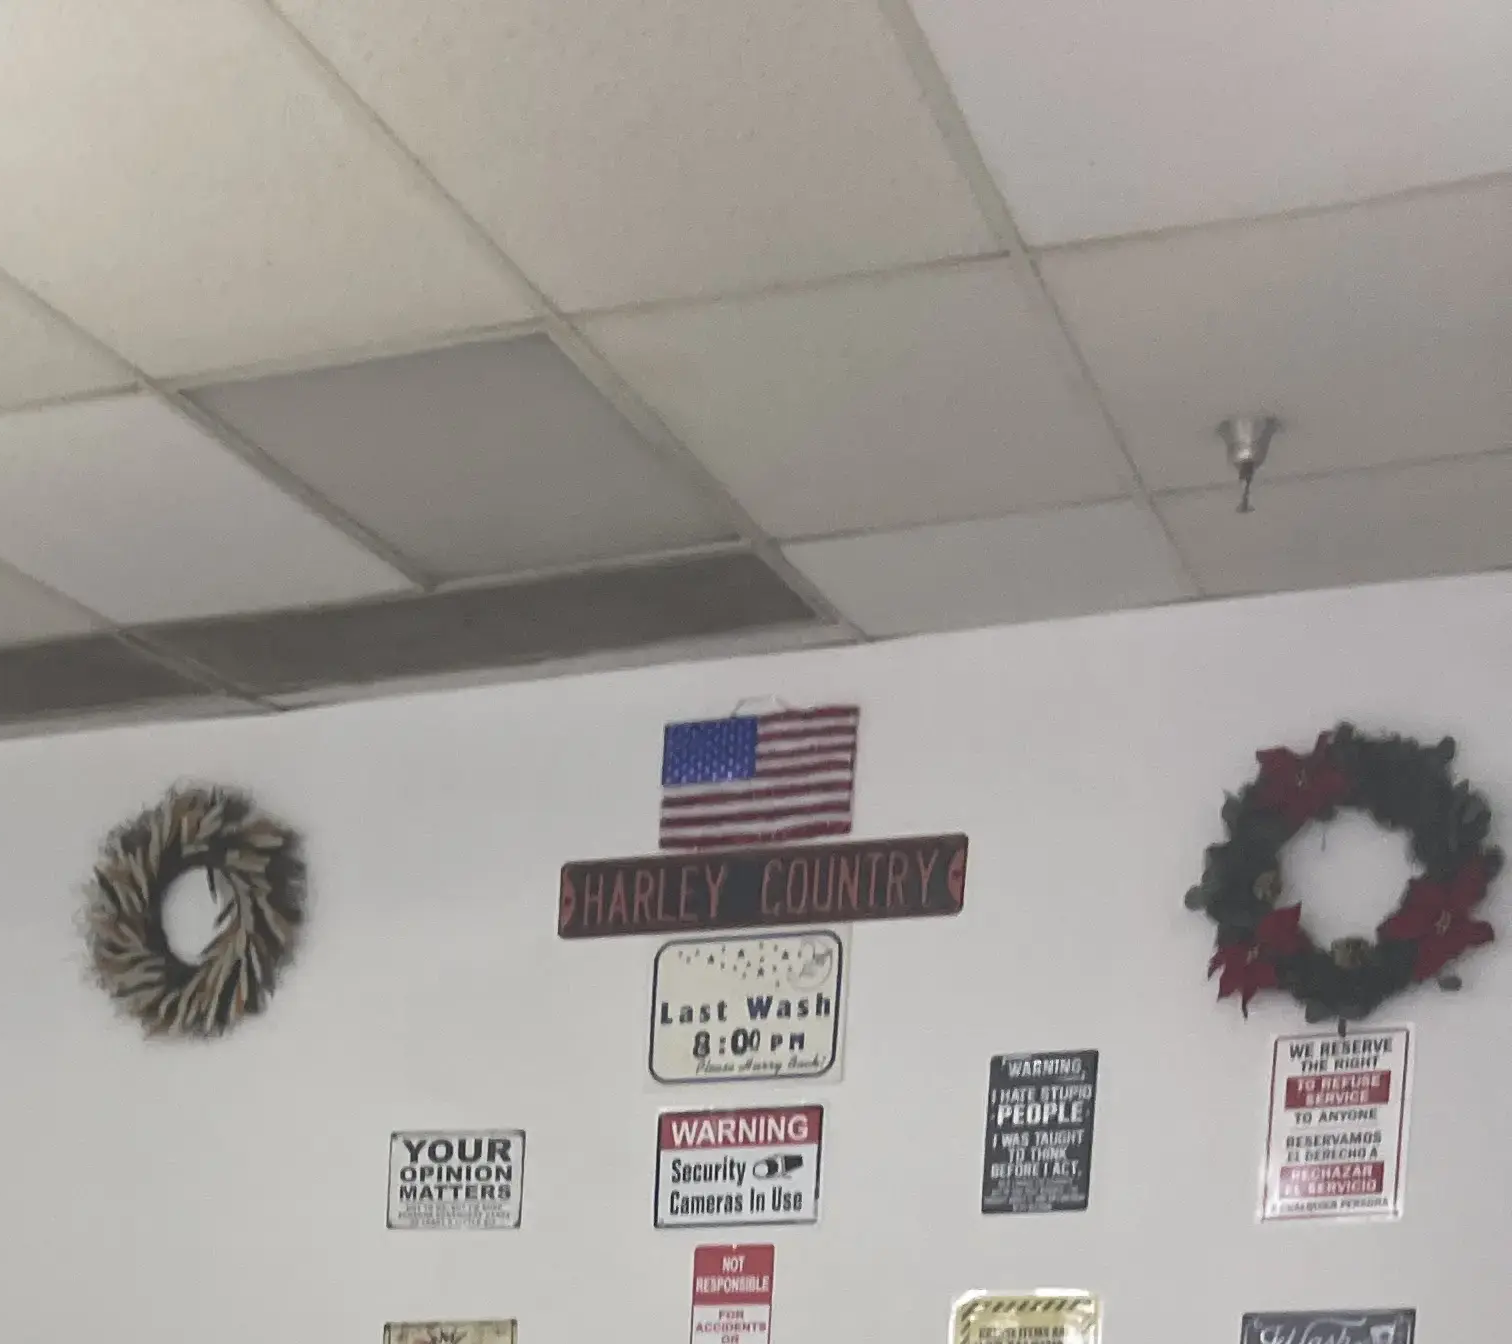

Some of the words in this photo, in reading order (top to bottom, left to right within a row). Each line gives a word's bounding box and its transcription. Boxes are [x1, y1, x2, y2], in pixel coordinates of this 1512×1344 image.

[583, 862, 729, 926] HARLEY
[759, 848, 940, 917] COUNTRY
[660, 1000, 728, 1024] Last
[747, 992, 831, 1020] Wash
[693, 1027, 761, 1058] 8:00
[1289, 1041, 1314, 1059] WE
[1319, 1037, 1394, 1058] RESERVE
[1300, 1058, 1328, 1073] THE
[1333, 1055, 1379, 1071] RIGHT
[1297, 1077, 1316, 1092] TO
[1321, 1074, 1381, 1089] REFUSE
[1000, 1086, 1036, 1103] HATE
[1040, 1083, 1093, 1101] STUPID
[1305, 1089, 1370, 1107] SERVICE
[997, 1102, 1083, 1127] PEOPLE
[1294, 1111, 1313, 1125] TO
[1318, 1107, 1378, 1124] ANYONE
[671, 1113, 809, 1147] WARNING
[1001, 1131, 1030, 1148] WAS
[1035, 1129, 1085, 1147] TAUGHT
[1285, 1130, 1383, 1149] RESERVAMOS
[402, 1136, 512, 1163] YOUR
[399, 1165, 513, 1183] OPINION
[671, 1154, 747, 1187] Security
[399, 1184, 511, 1201] MATTERS
[1307, 1178, 1377, 1195] SERVICIO
[669, 1189, 744, 1216] Cameras
[750, 1187, 765, 1214] In
[771, 1184, 803, 1212] Use
[722, 1255, 745, 1273] NOT
[695, 1275, 770, 1294] RESPONSIBLE
[695, 1321, 766, 1333] ACCIDENTS
